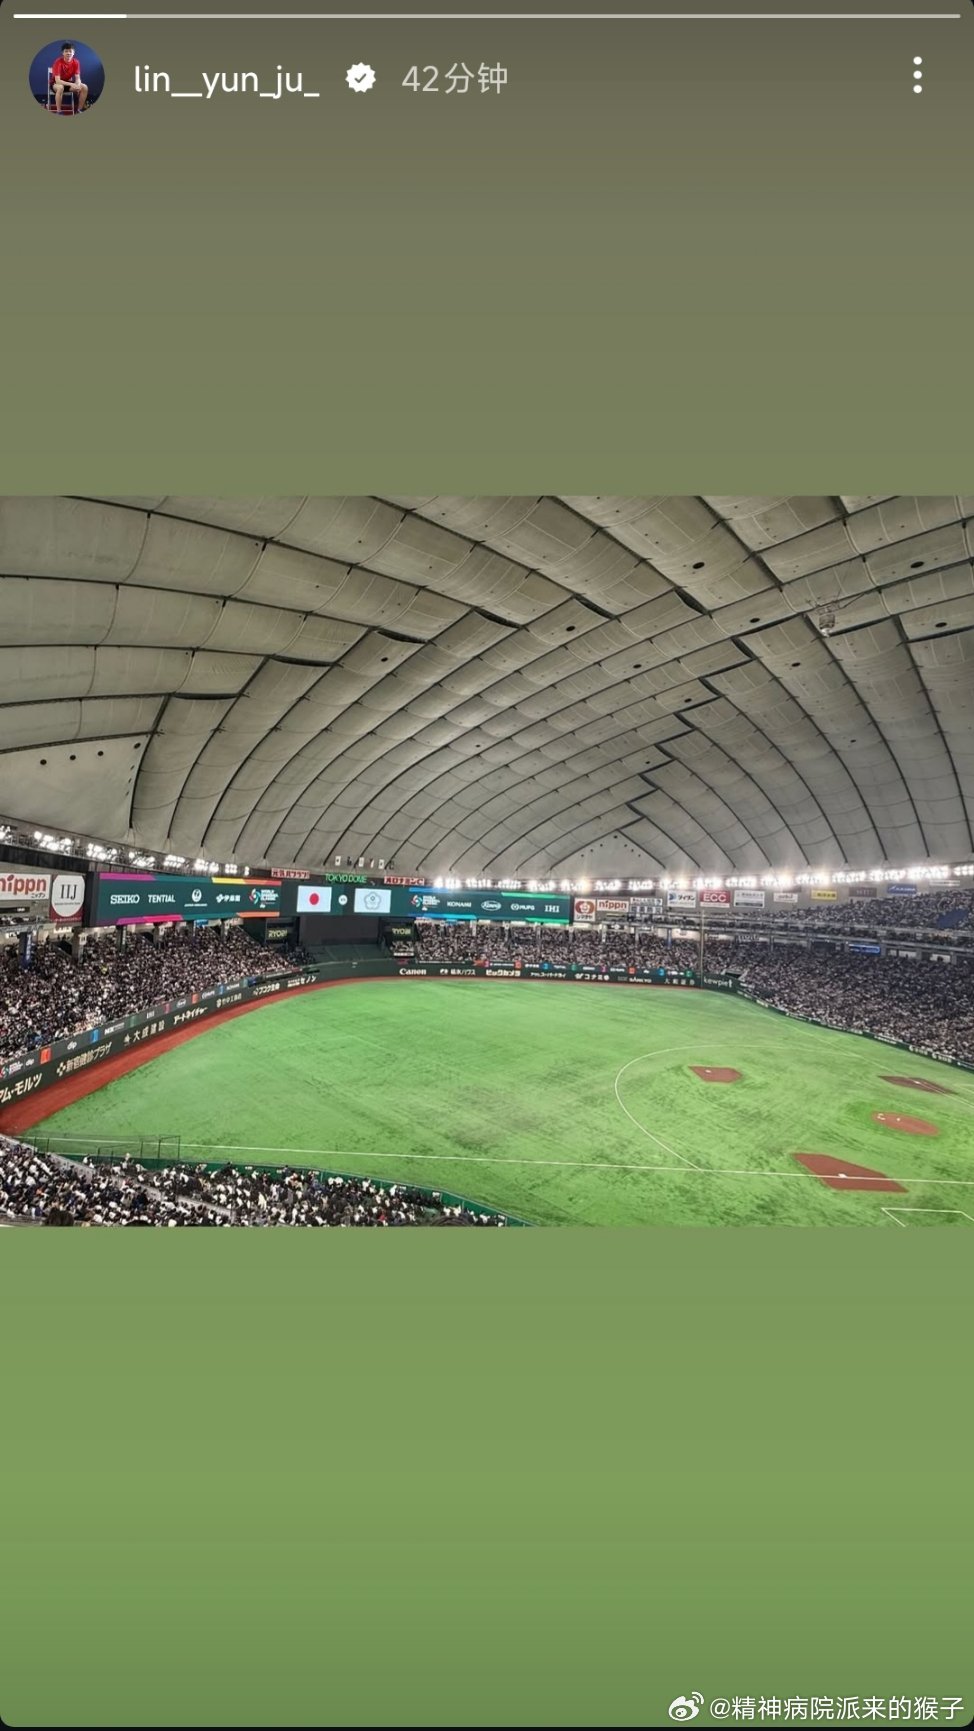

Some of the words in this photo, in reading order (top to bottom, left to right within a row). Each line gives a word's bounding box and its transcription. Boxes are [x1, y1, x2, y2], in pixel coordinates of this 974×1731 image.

[326, 873, 347, 882] TOKYO
[60, 884, 78, 900] IIJ
[110, 894, 140, 905] SEIKO
[148, 894, 175, 903] TENTIAL
[703, 893, 727, 903] ECC
[544, 904, 560, 913] IHI
[598, 900, 627, 910] nippn
[399, 967, 427, 976] Canon
